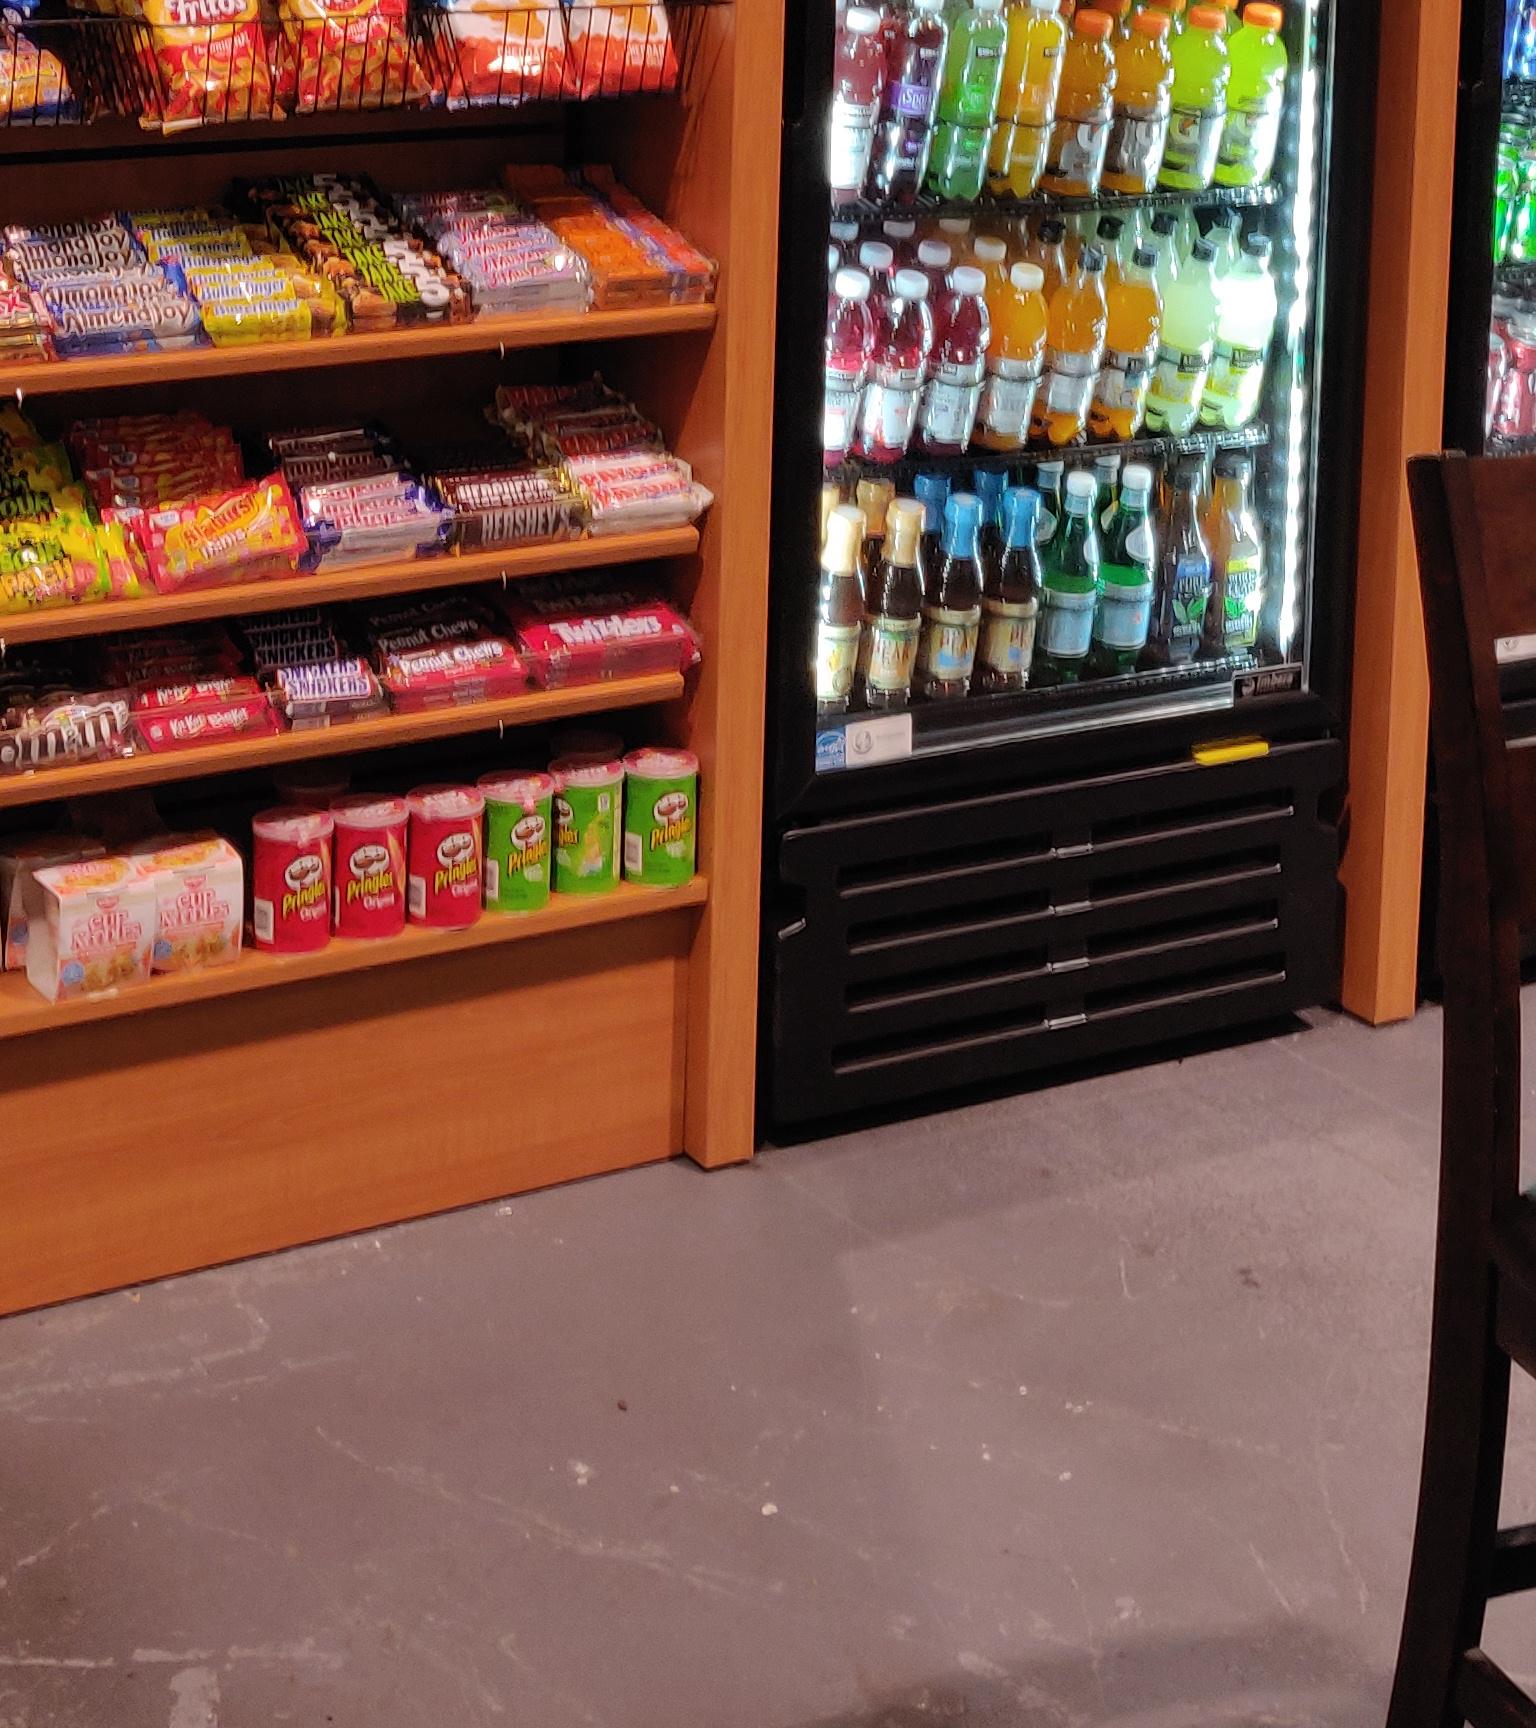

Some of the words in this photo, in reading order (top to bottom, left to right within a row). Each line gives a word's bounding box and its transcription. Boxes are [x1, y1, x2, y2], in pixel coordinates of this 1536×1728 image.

[399, 652, 453, 675] Peanut
[454, 639, 504, 663] Chews
[346, 871, 393, 902] Pringles
